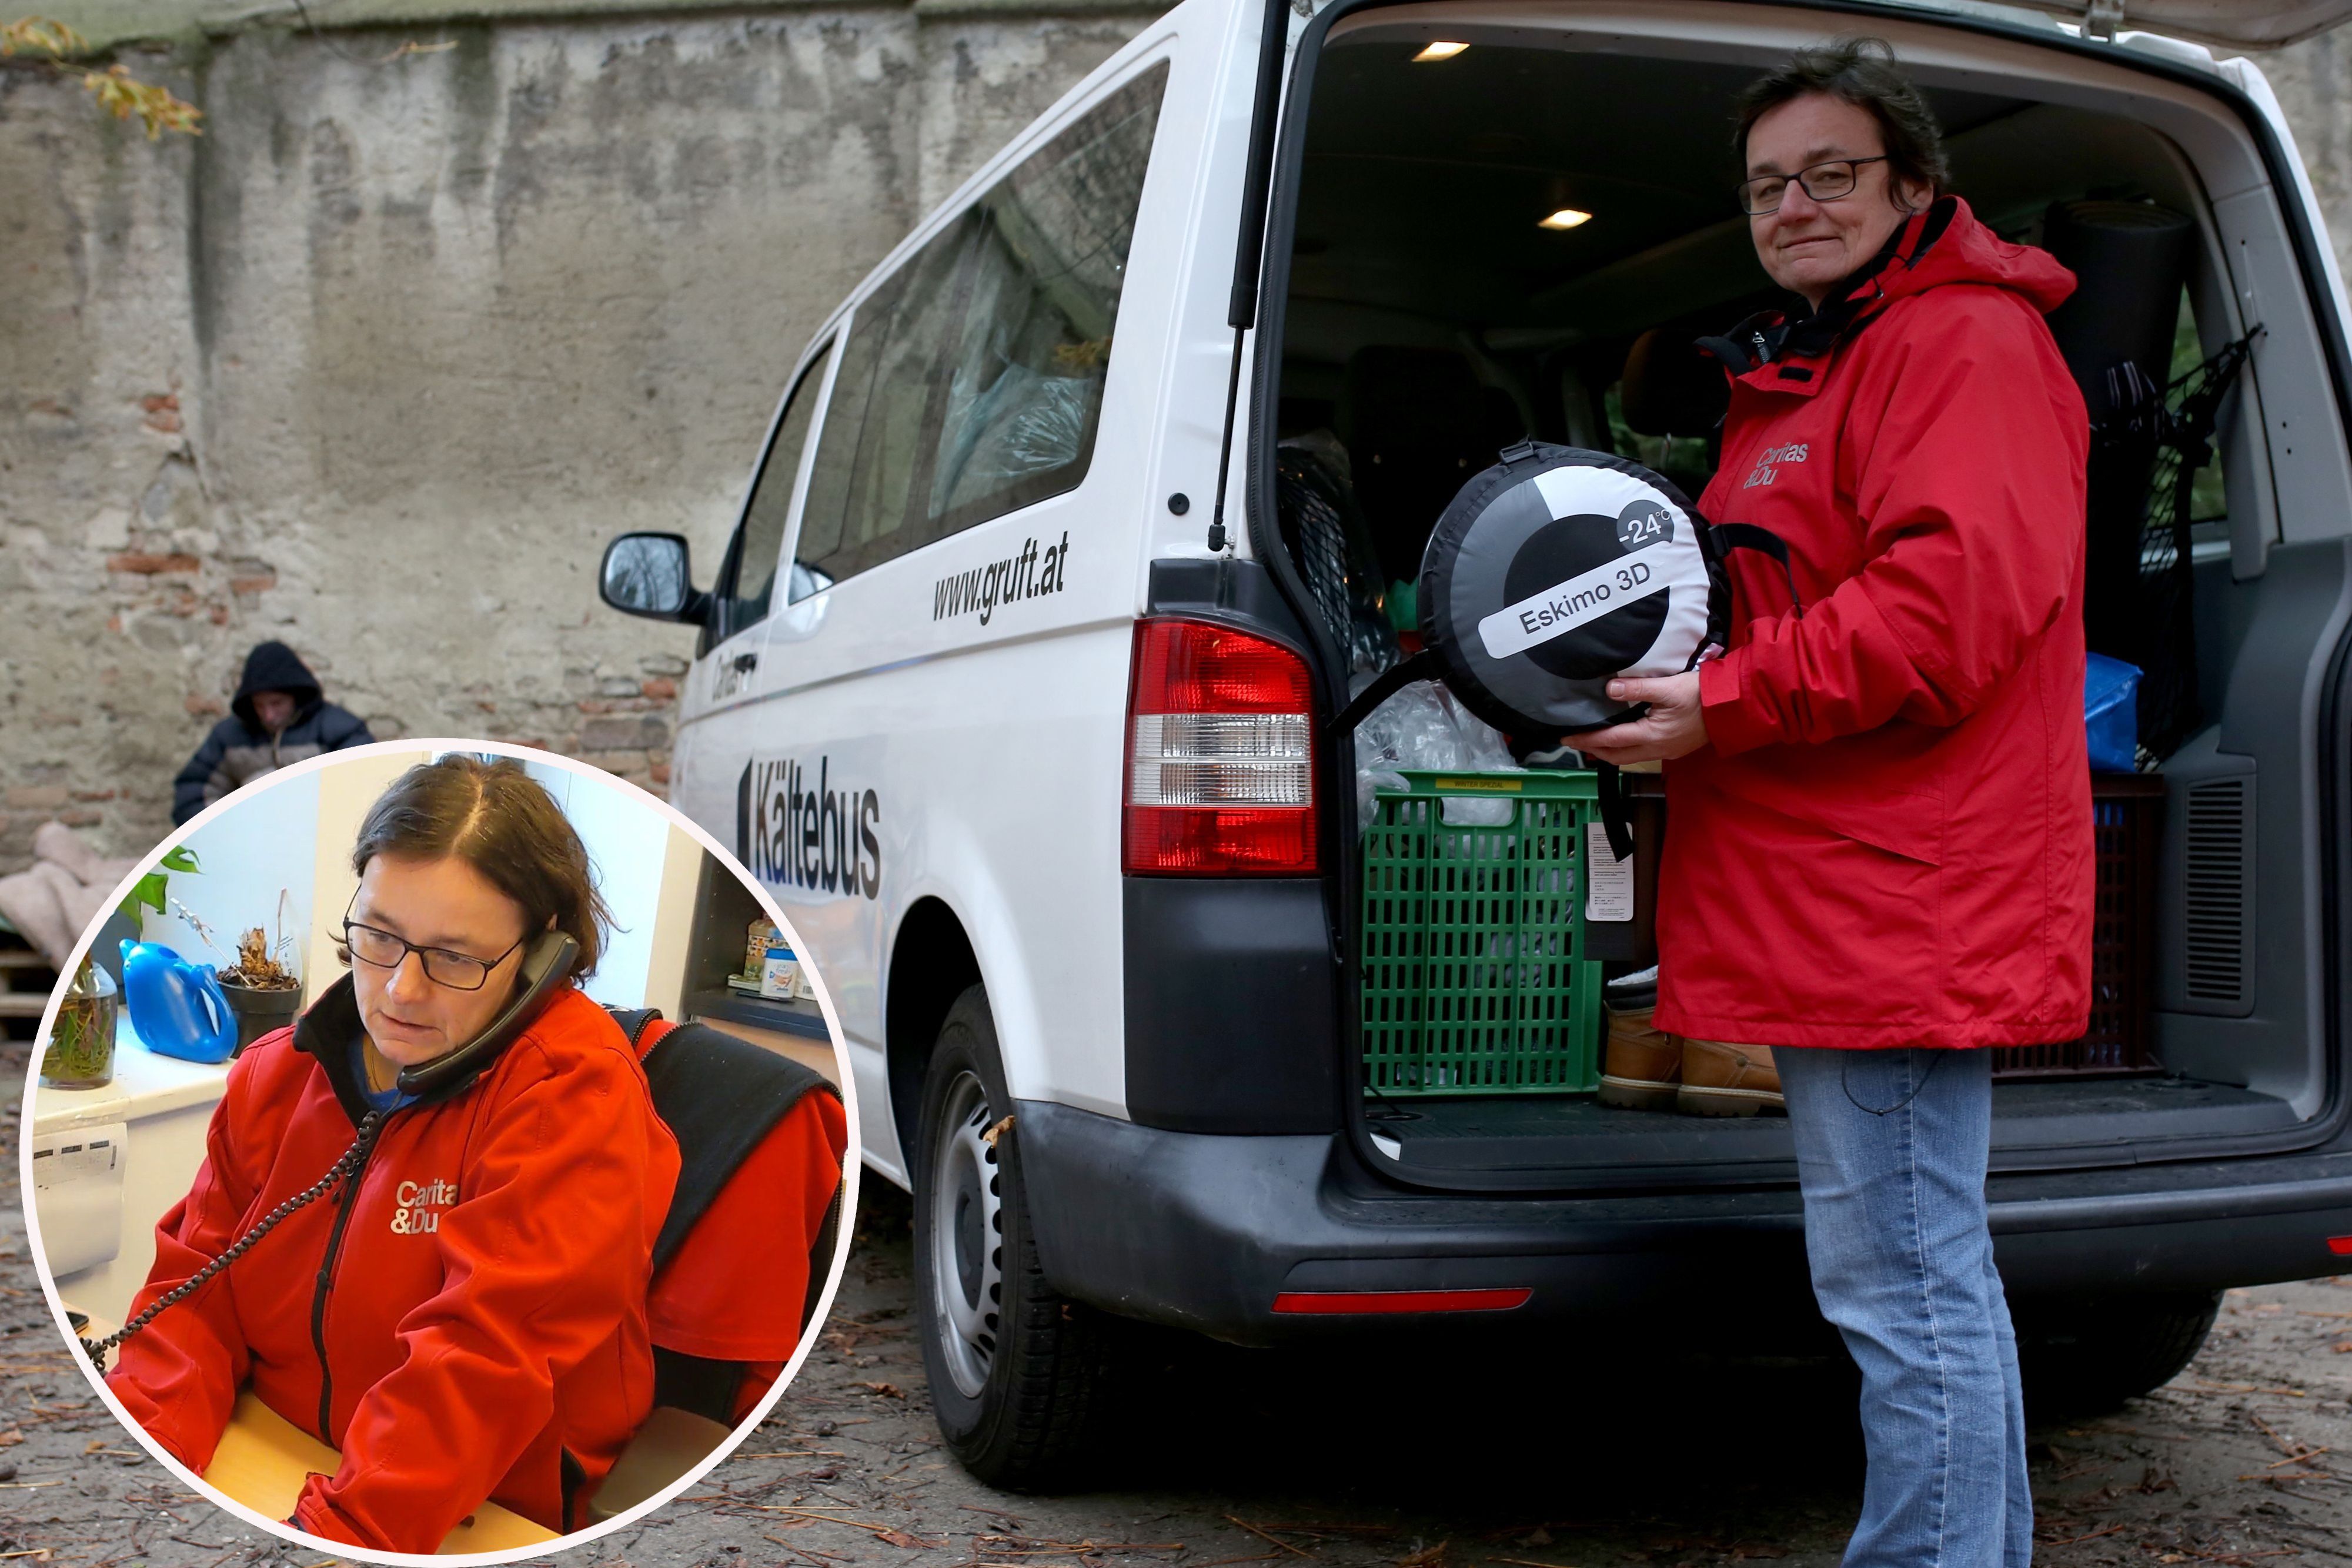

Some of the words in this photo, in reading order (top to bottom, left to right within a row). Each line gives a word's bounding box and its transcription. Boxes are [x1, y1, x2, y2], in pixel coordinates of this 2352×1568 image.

[1743, 466, 1778, 489] &Du
[934, 530, 1068, 626] www.gruft.at
[1519, 584, 1611, 634] Eskimo
[1616, 562, 1650, 591] 3D
[756, 755, 880, 900] Kältebus
[396, 1178, 458, 1207] Carita
[390, 1208, 439, 1234] &Du
